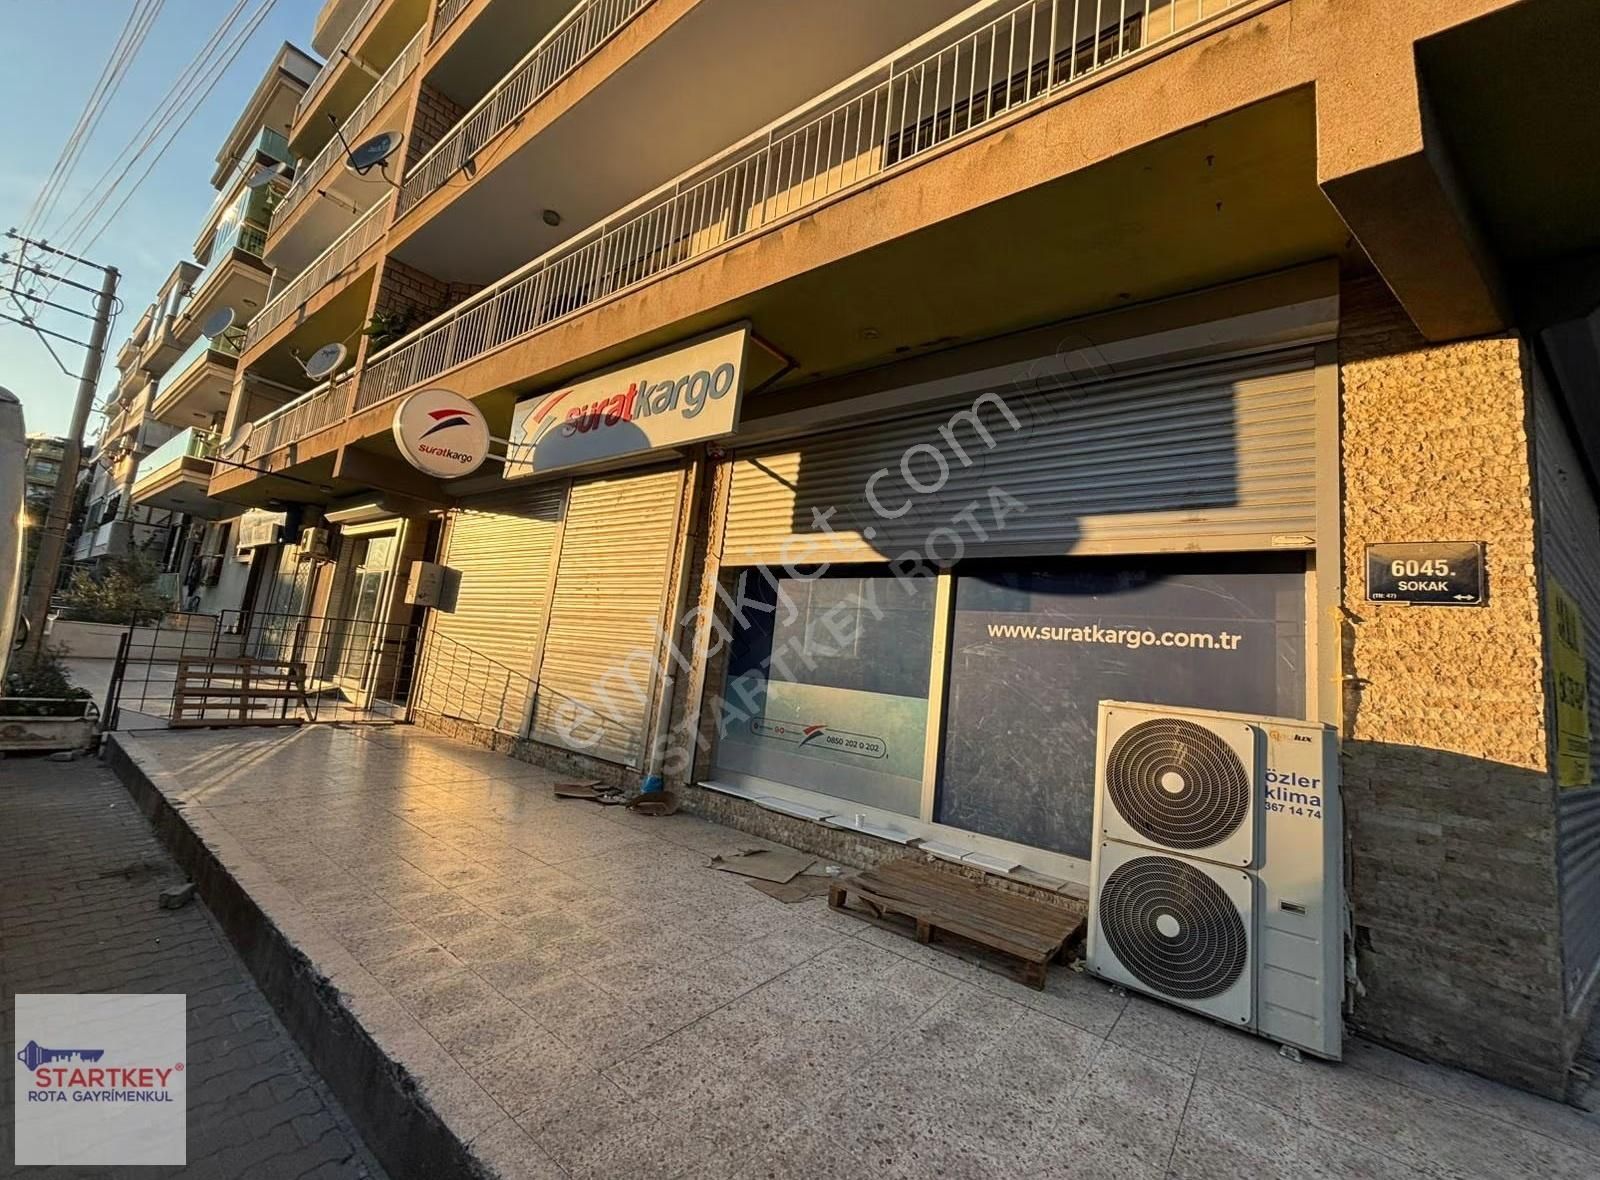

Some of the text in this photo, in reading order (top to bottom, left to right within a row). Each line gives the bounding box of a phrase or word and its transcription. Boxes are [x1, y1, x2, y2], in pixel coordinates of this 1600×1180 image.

[1391, 559, 1457, 577] 6045.
[1398, 581, 1449, 592] SOKAK
[987, 623, 1242, 650] www.suratkargo.com.tr
[826, 735, 844, 746] 0850
[845, 739, 858, 749] 202
[865, 743, 880, 752] 202
[1265, 768, 1321, 788] özler
[1264, 784, 1321, 807] klima
[1264, 801, 1321, 819] 367 14 74
